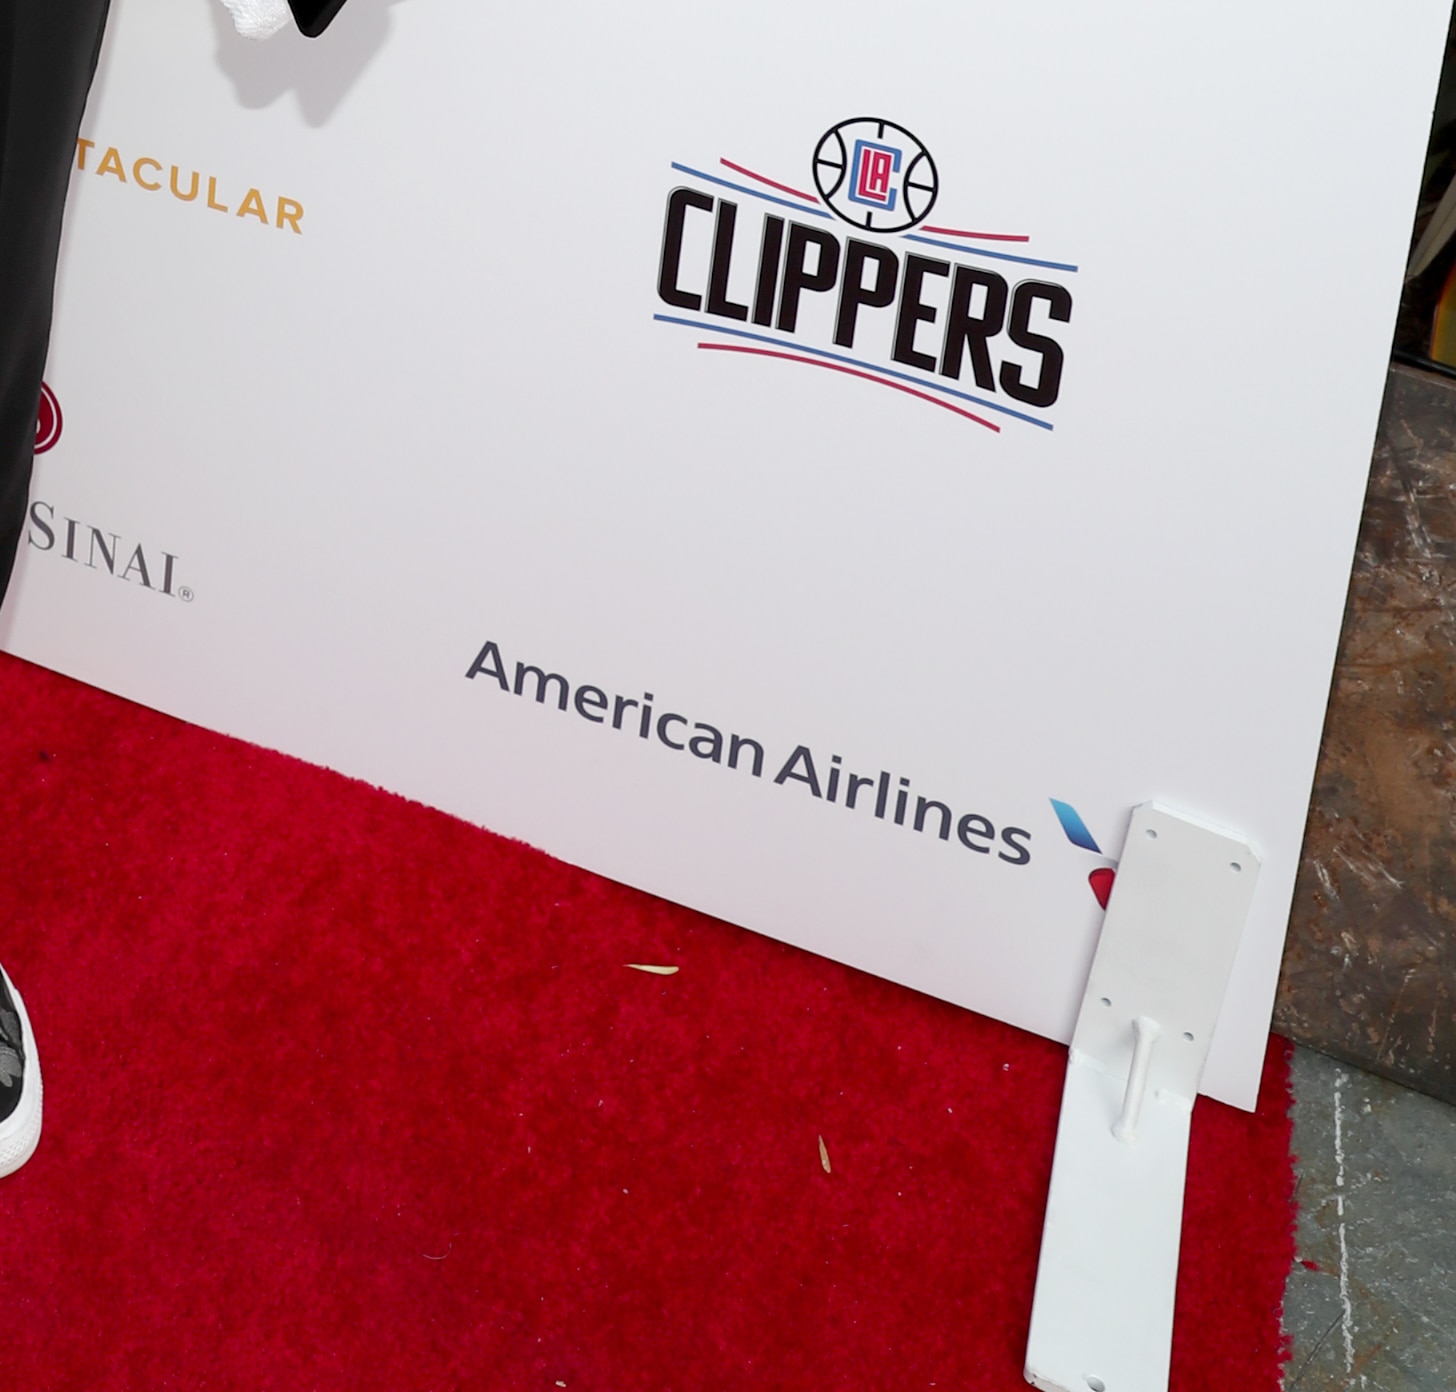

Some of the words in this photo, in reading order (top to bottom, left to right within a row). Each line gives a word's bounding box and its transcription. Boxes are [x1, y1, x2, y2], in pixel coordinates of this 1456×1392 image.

[654, 184, 1073, 409] CLIPPERS
[464, 640, 765, 779] American
[772, 744, 1032, 866] Airlines
